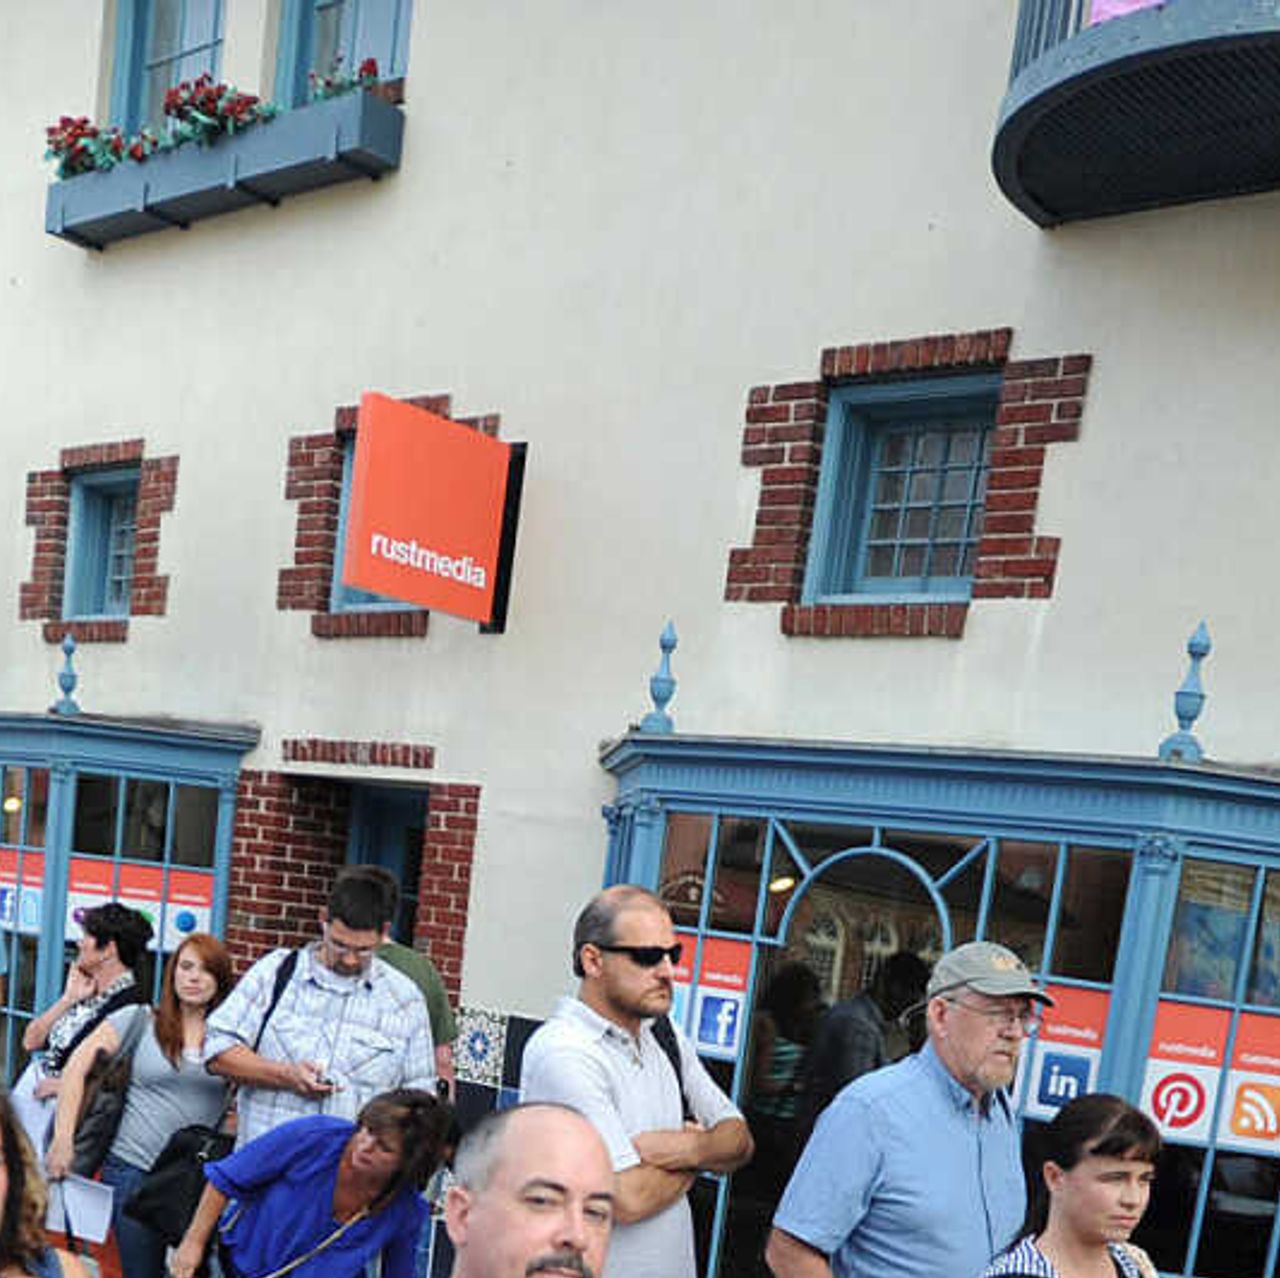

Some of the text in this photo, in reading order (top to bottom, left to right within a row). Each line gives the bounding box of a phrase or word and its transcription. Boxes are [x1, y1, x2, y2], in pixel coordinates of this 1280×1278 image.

[371, 533, 487, 588] rustmedia
[717, 1001, 736, 1044] f
[1048, 1065, 1078, 1098] in
